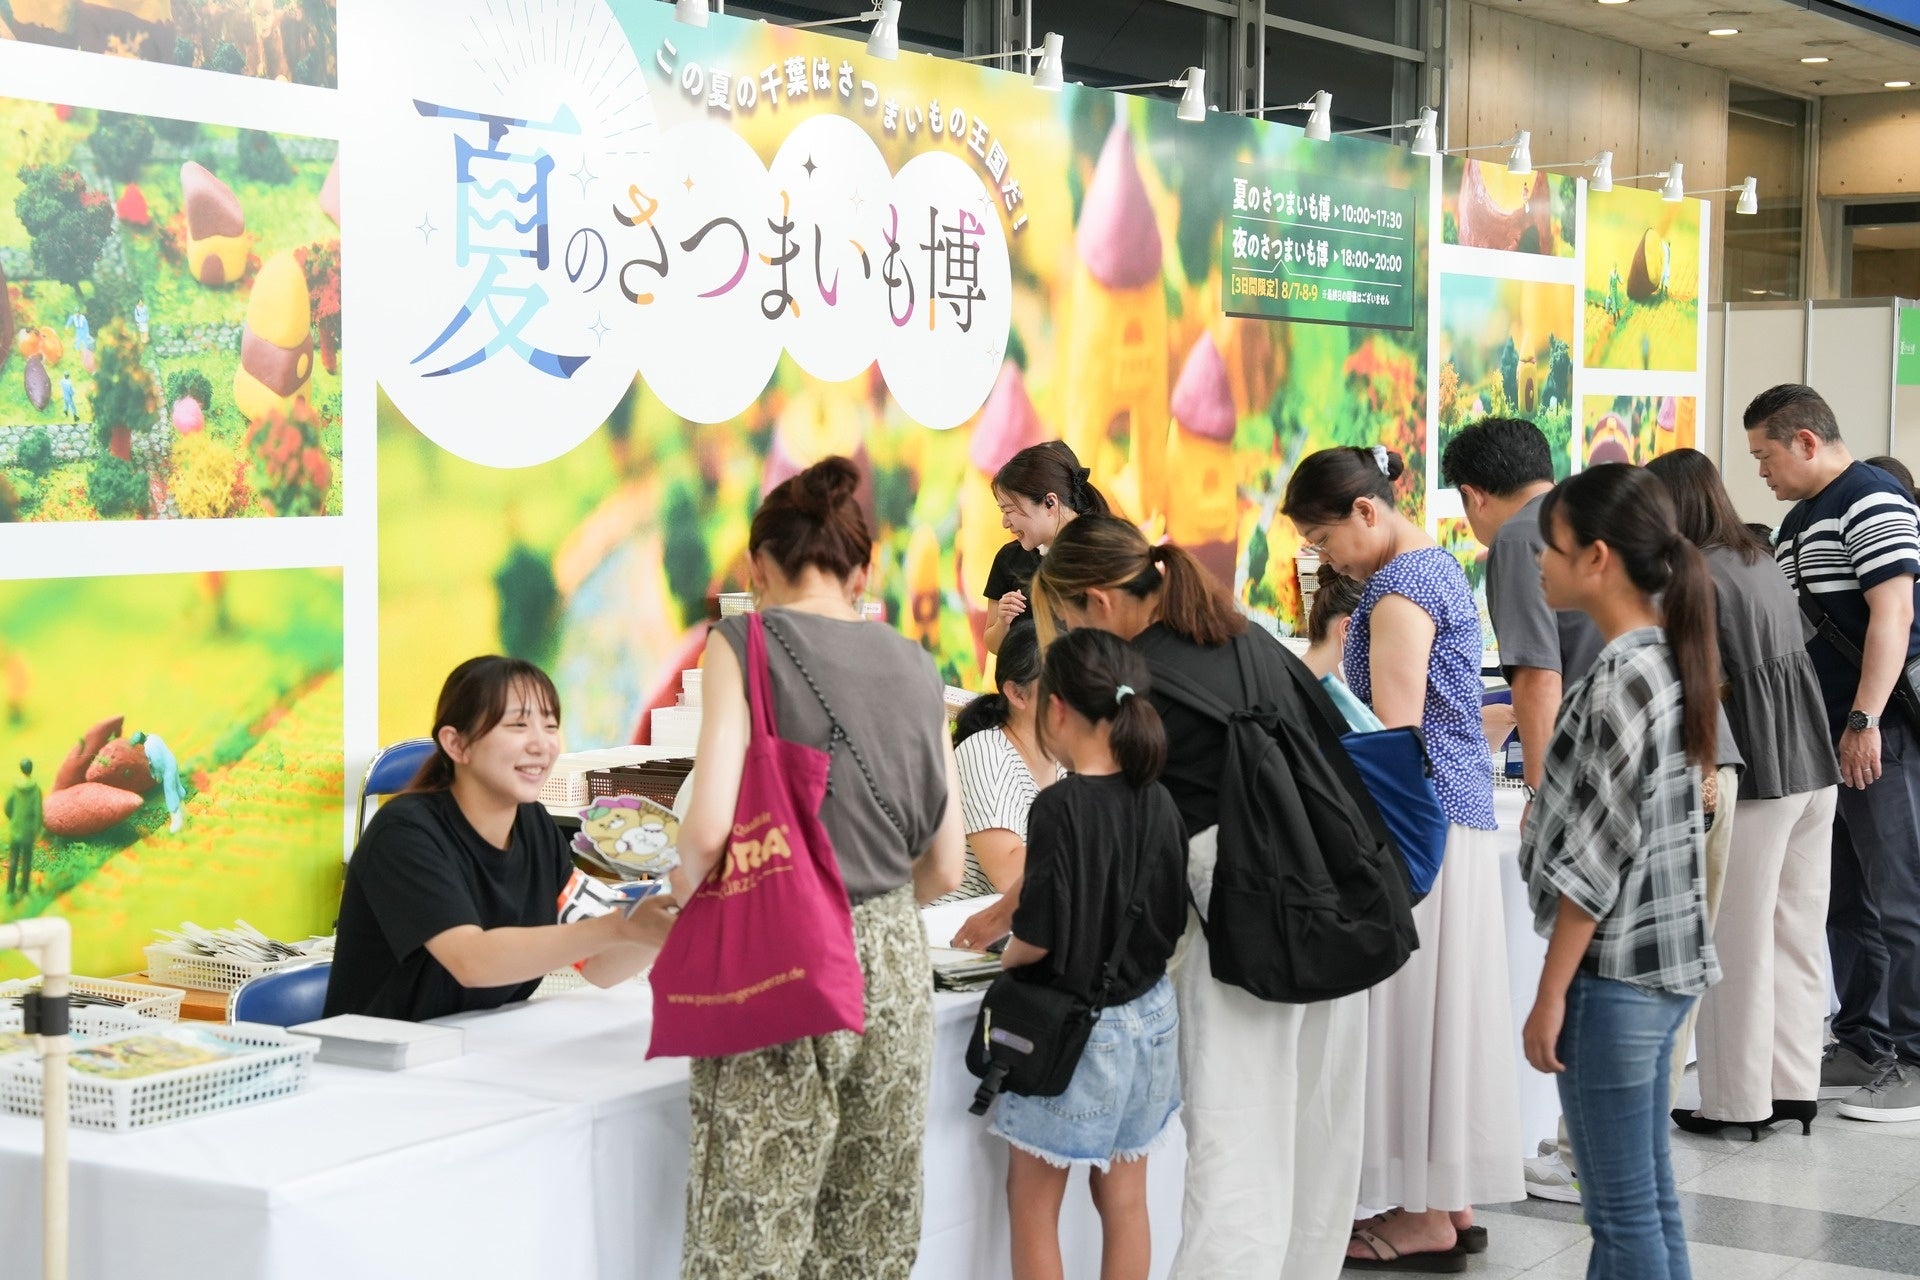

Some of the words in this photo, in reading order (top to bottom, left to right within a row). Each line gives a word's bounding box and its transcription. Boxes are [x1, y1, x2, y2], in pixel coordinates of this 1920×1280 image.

[1232, 177, 1331, 223] 夏のさつまいも博
[410, 97, 988, 381] 夏のさつまいも博
[1232, 226, 1330, 269] 夜のさつまいも博
